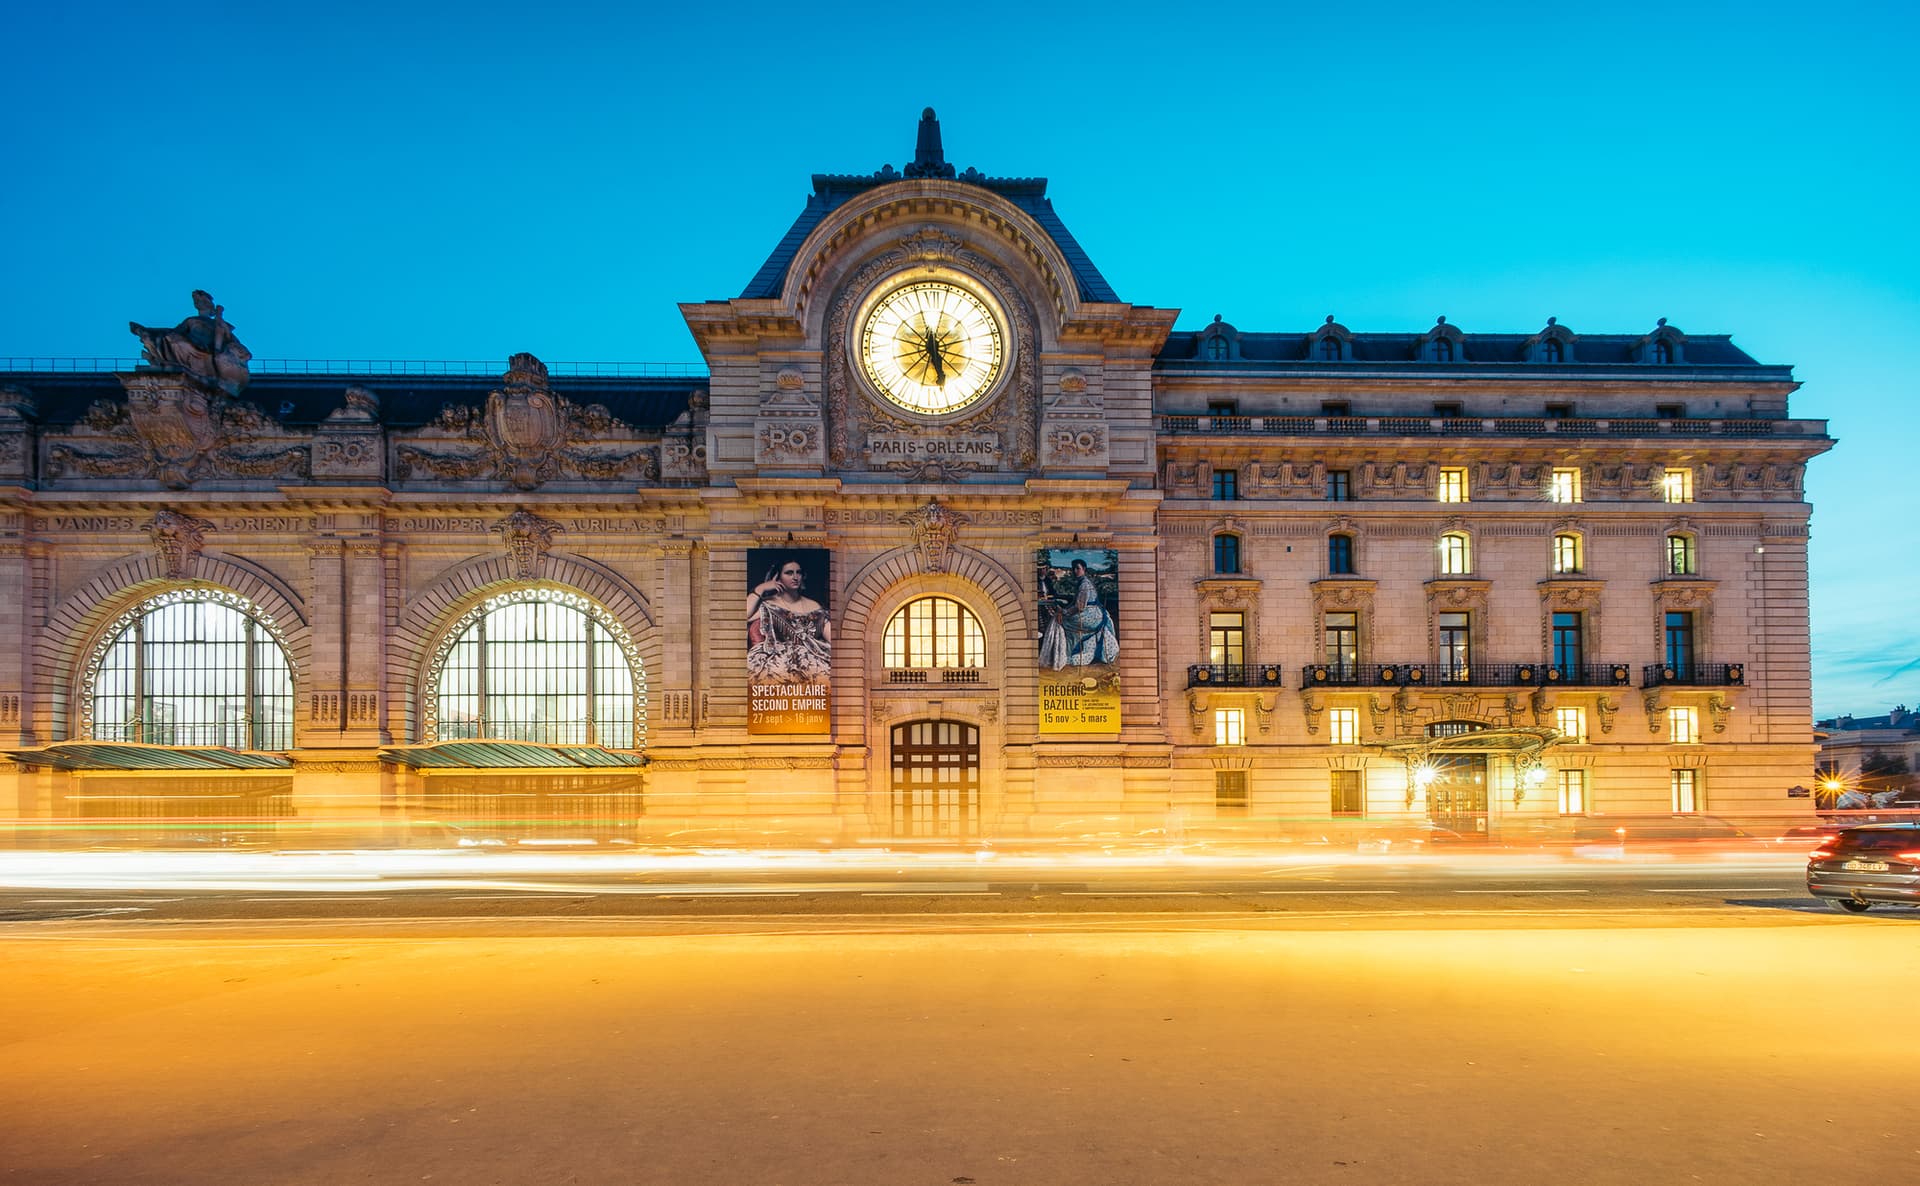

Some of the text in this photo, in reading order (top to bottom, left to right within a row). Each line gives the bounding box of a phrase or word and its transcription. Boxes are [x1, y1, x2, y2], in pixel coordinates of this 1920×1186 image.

[872, 441, 993, 455] PARIS-ORLEANS
[55, 517, 134, 531] VANNES
[222, 517, 301, 531] LORIENT
[843, 511, 896, 523] BLOIS
[971, 511, 1026, 524] TOURS
[403, 518, 486, 532] QUIMPER
[567, 518, 652, 532] AURILLAC
[752, 685, 826, 697] SPECTACULAIRE
[1043, 682, 1087, 697] FRÉDÉRIC
[752, 699, 827, 711] SECOND EMPIRE
[1044, 699, 1080, 711] BAZILLE
[753, 713, 763, 723] 27
[765, 714, 783, 726] sept
[795, 712, 805, 723] 16
[806, 713, 824, 725] janv
[1044, 713, 1053, 723] 15
[1055, 715, 1070, 723] nov
[1081, 713, 1086, 723] 5
[1088, 715, 1108, 723] mars
